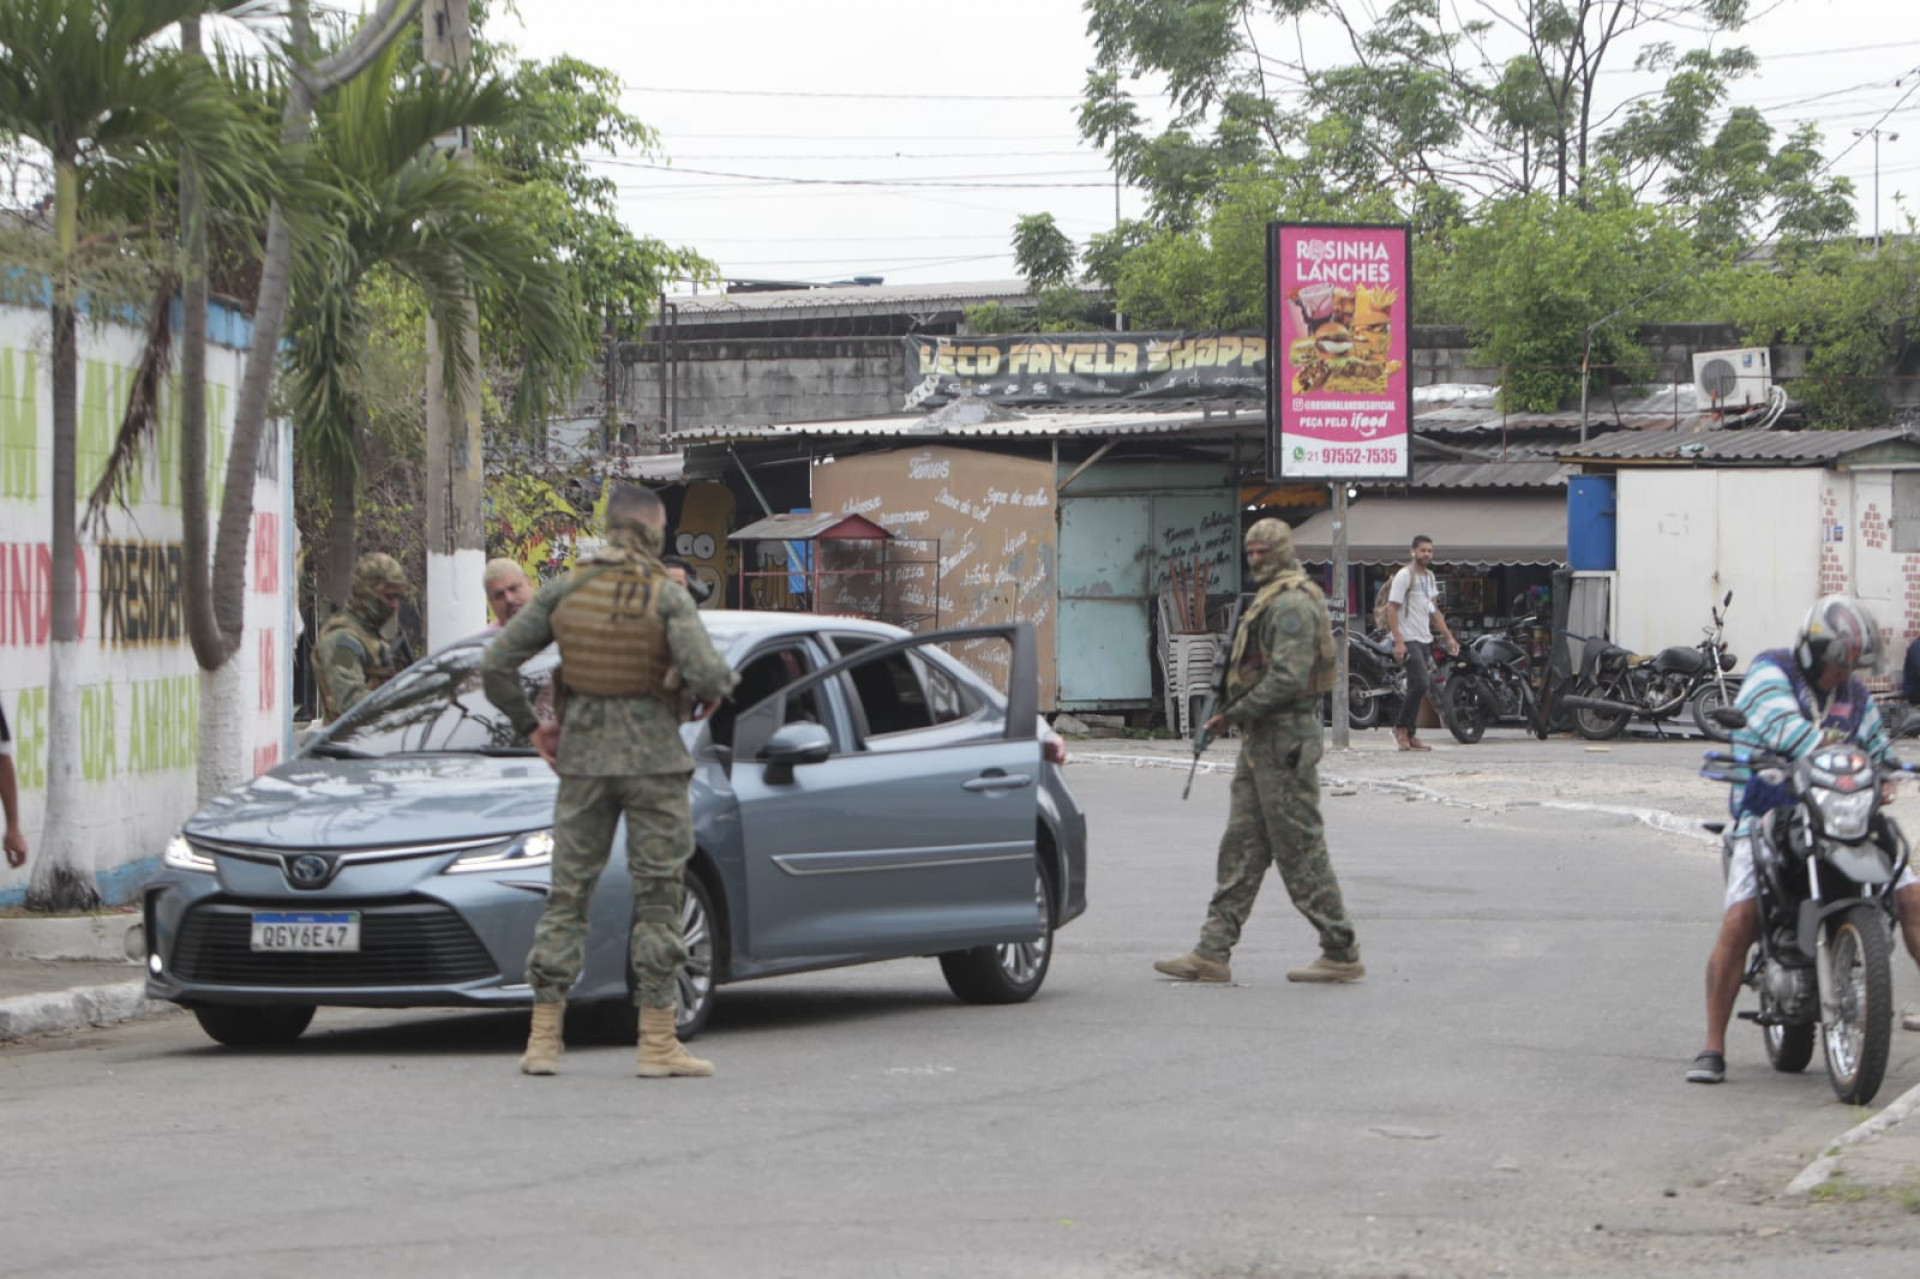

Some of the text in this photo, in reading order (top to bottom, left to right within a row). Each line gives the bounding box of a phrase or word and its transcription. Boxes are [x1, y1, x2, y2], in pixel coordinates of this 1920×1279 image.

[1296, 263, 1390, 283] LANCHES
[1008, 344, 1138, 375] FAVELA
[1300, 417, 1322, 429] PEÇA
[1325, 417, 1348, 428] PELO
[1307, 448, 1398, 464] 21 97552-7535
[99, 536, 189, 652] PRESIDE
[262, 925, 349, 948] QGY6E47
